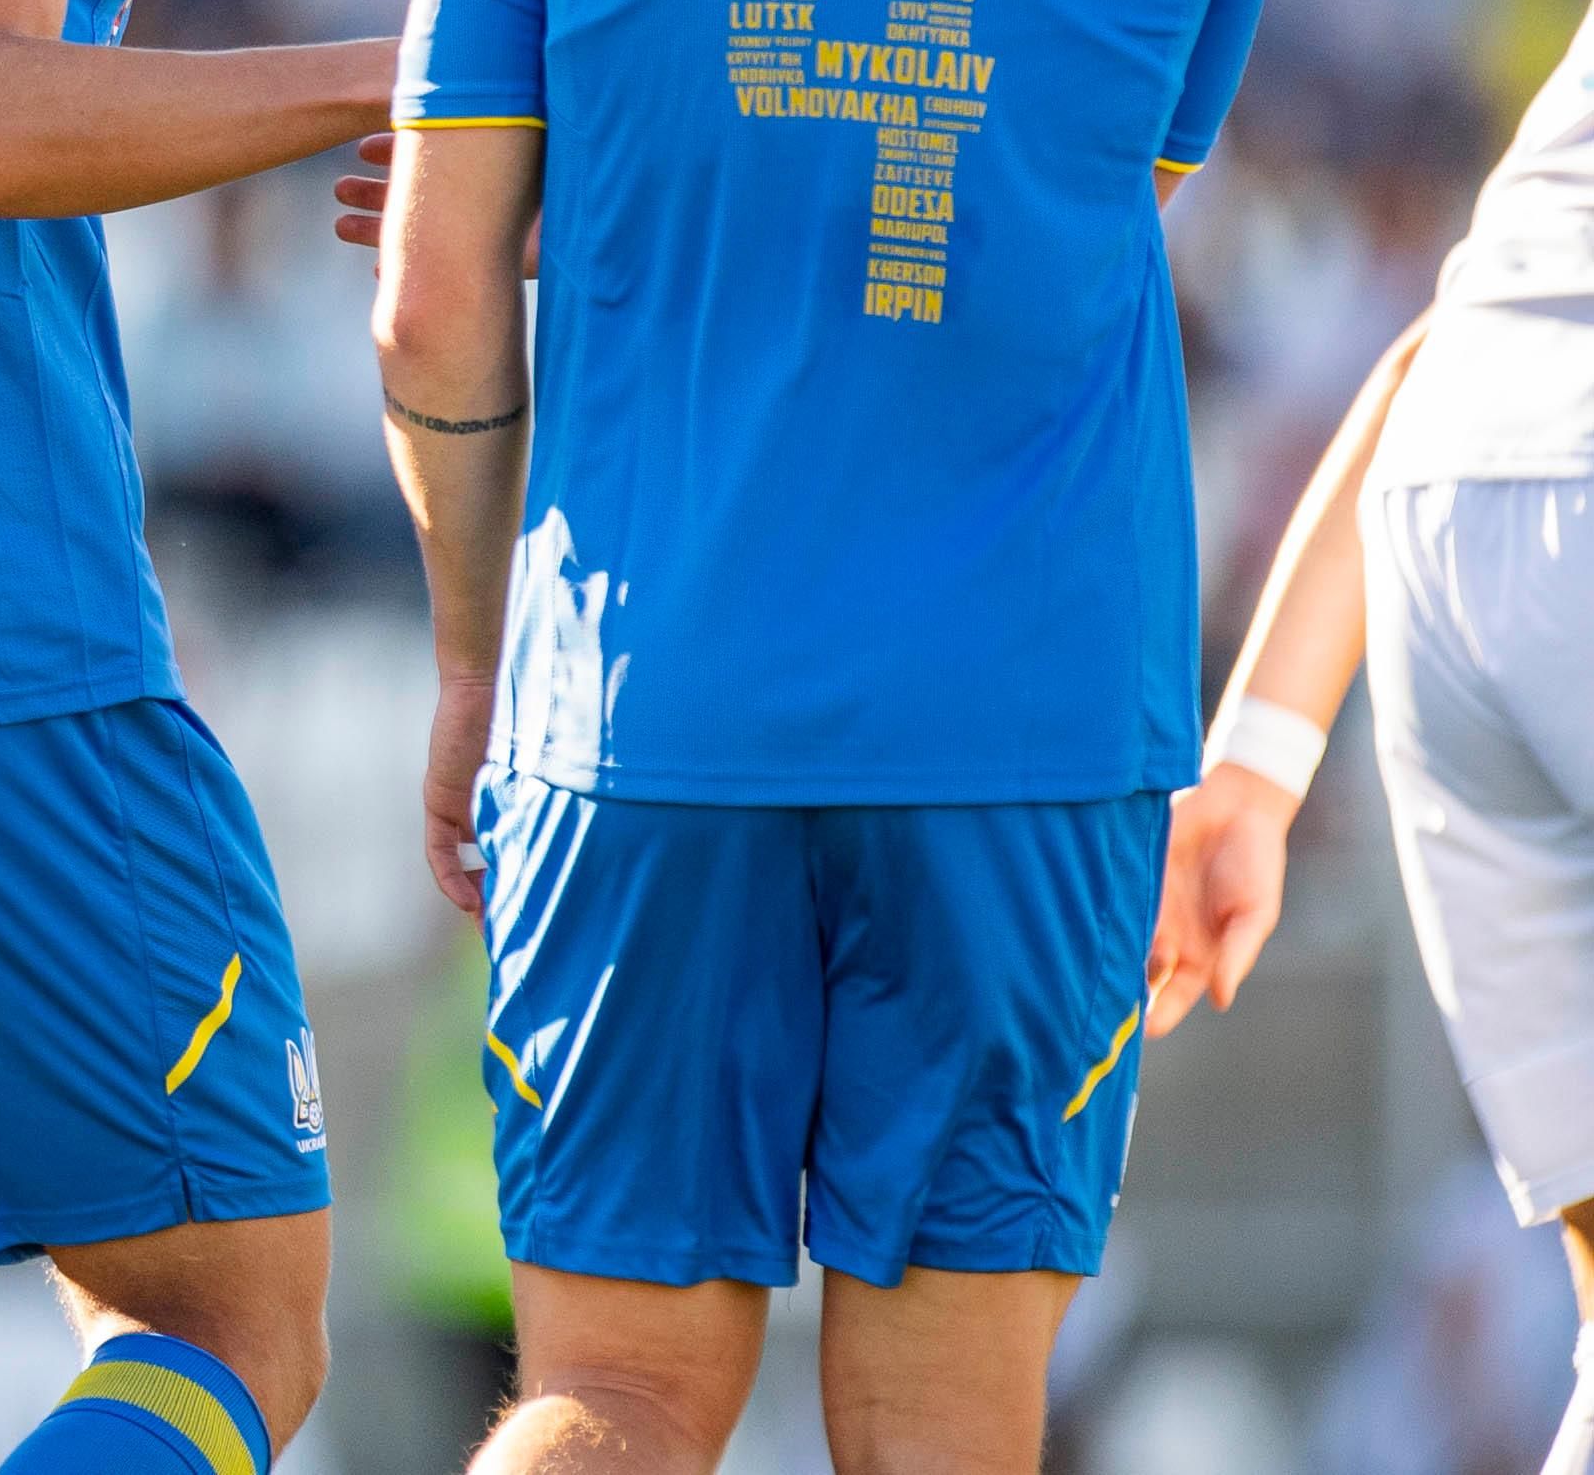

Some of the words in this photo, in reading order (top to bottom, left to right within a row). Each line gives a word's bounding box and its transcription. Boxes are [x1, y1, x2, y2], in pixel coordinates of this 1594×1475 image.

[730, 2, 815, 30] LUTSK
[889, 1, 927, 20] LVIV
[886, 23, 971, 48] OKHTYRKA
[817, 40, 995, 94] MYKOLAIV
[737, 86, 919, 127] VOLNOVAKHA
[877, 127, 959, 153] HOSTOMEL
[874, 162, 954, 188] ZAITSEVE
[871, 184, 955, 222] ODESA
[870, 218, 949, 245] MARIUPOL
[867, 258, 946, 287] KHERSON
[863, 282, 943, 324] IRPIN
